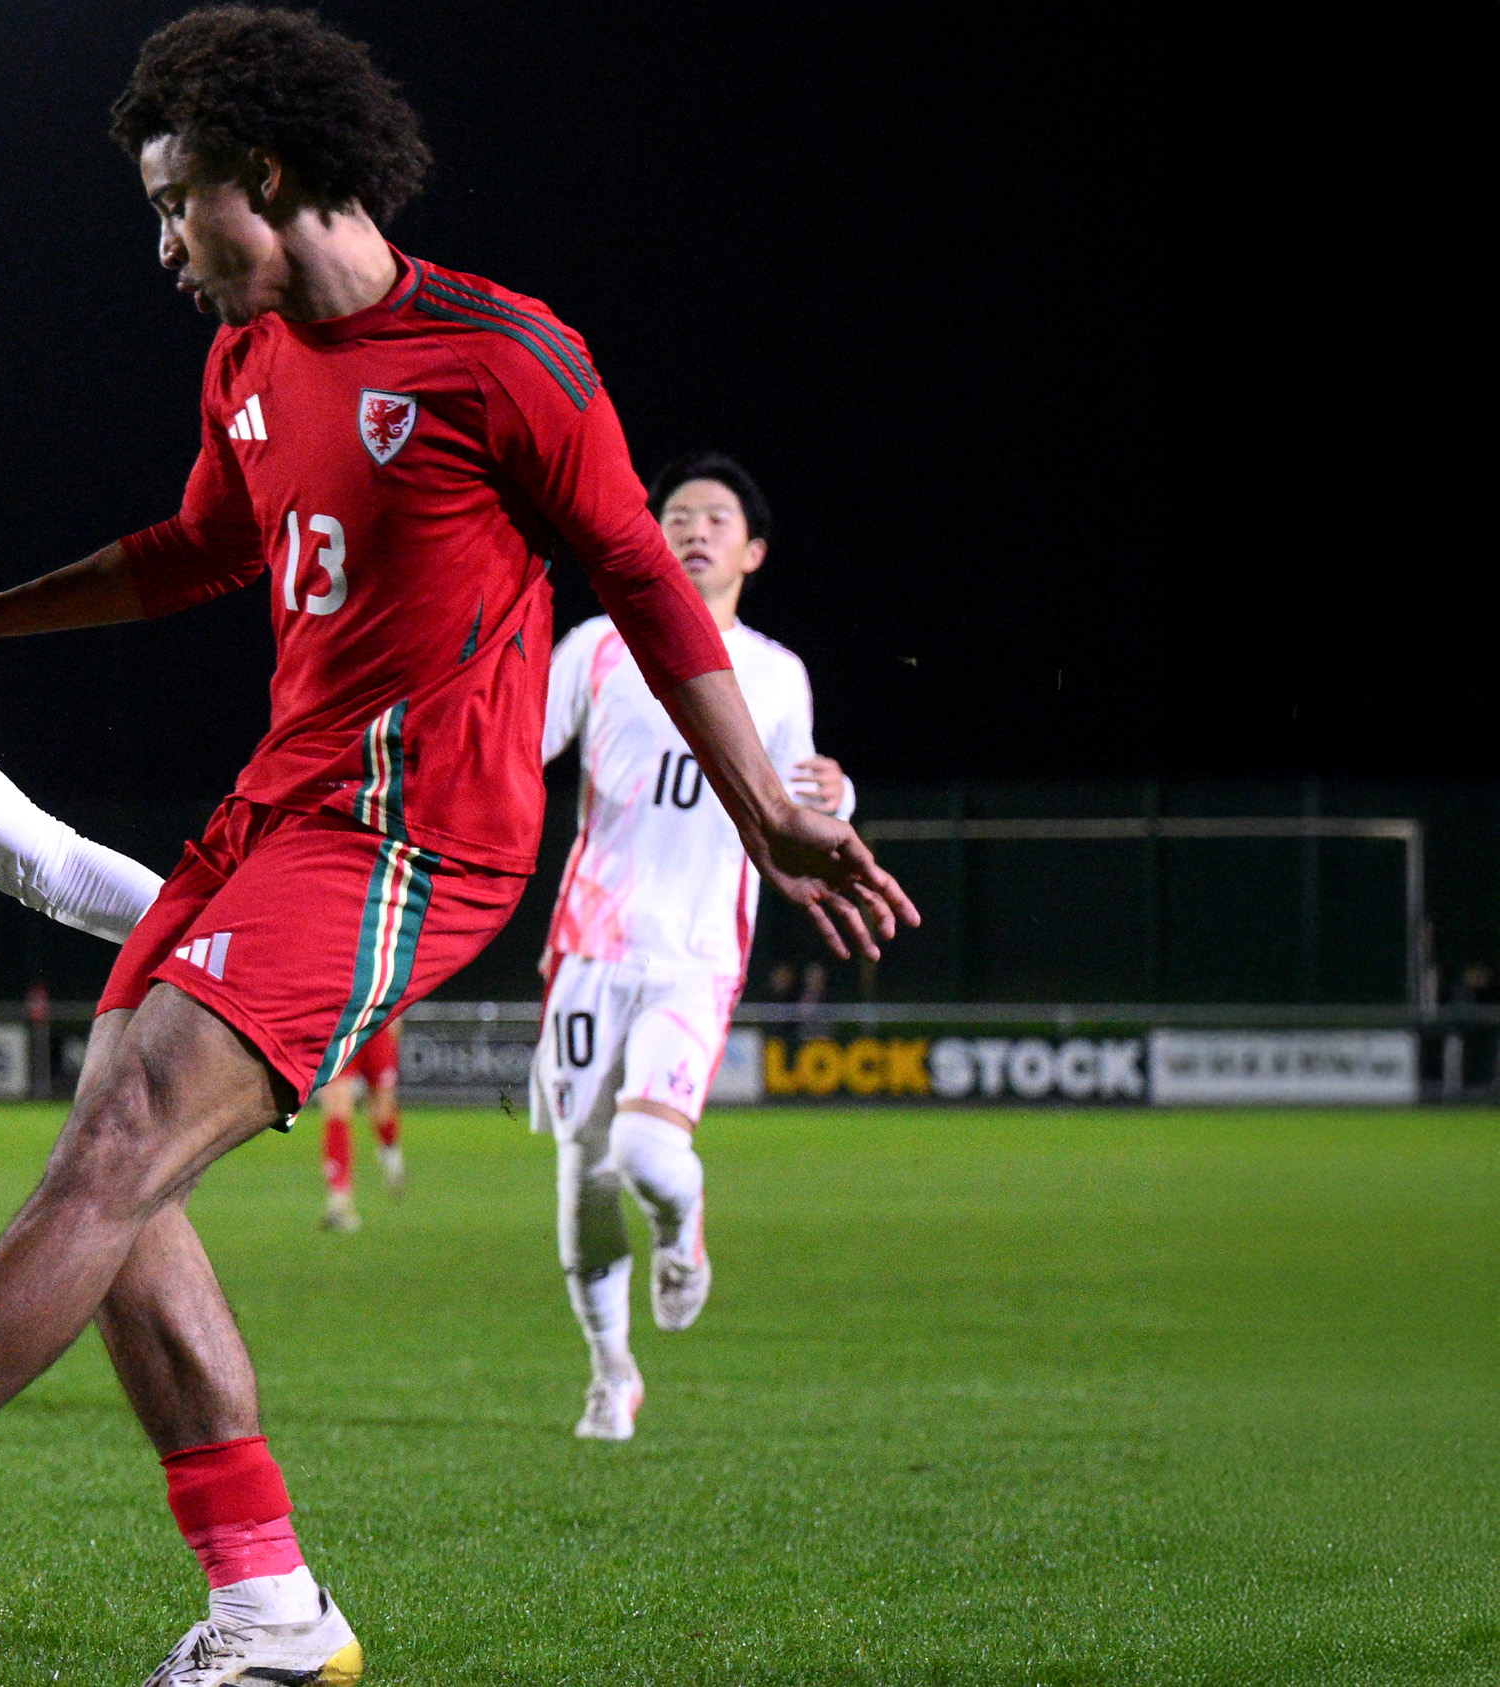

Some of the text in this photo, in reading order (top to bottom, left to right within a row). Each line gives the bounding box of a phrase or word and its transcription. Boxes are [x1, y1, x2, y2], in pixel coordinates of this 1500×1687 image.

[284, 510, 348, 616] 13
[654, 750, 703, 810] 10
[554, 1012, 595, 1069] 10
[763, 1036, 1146, 1096] LOCKSTOCK
